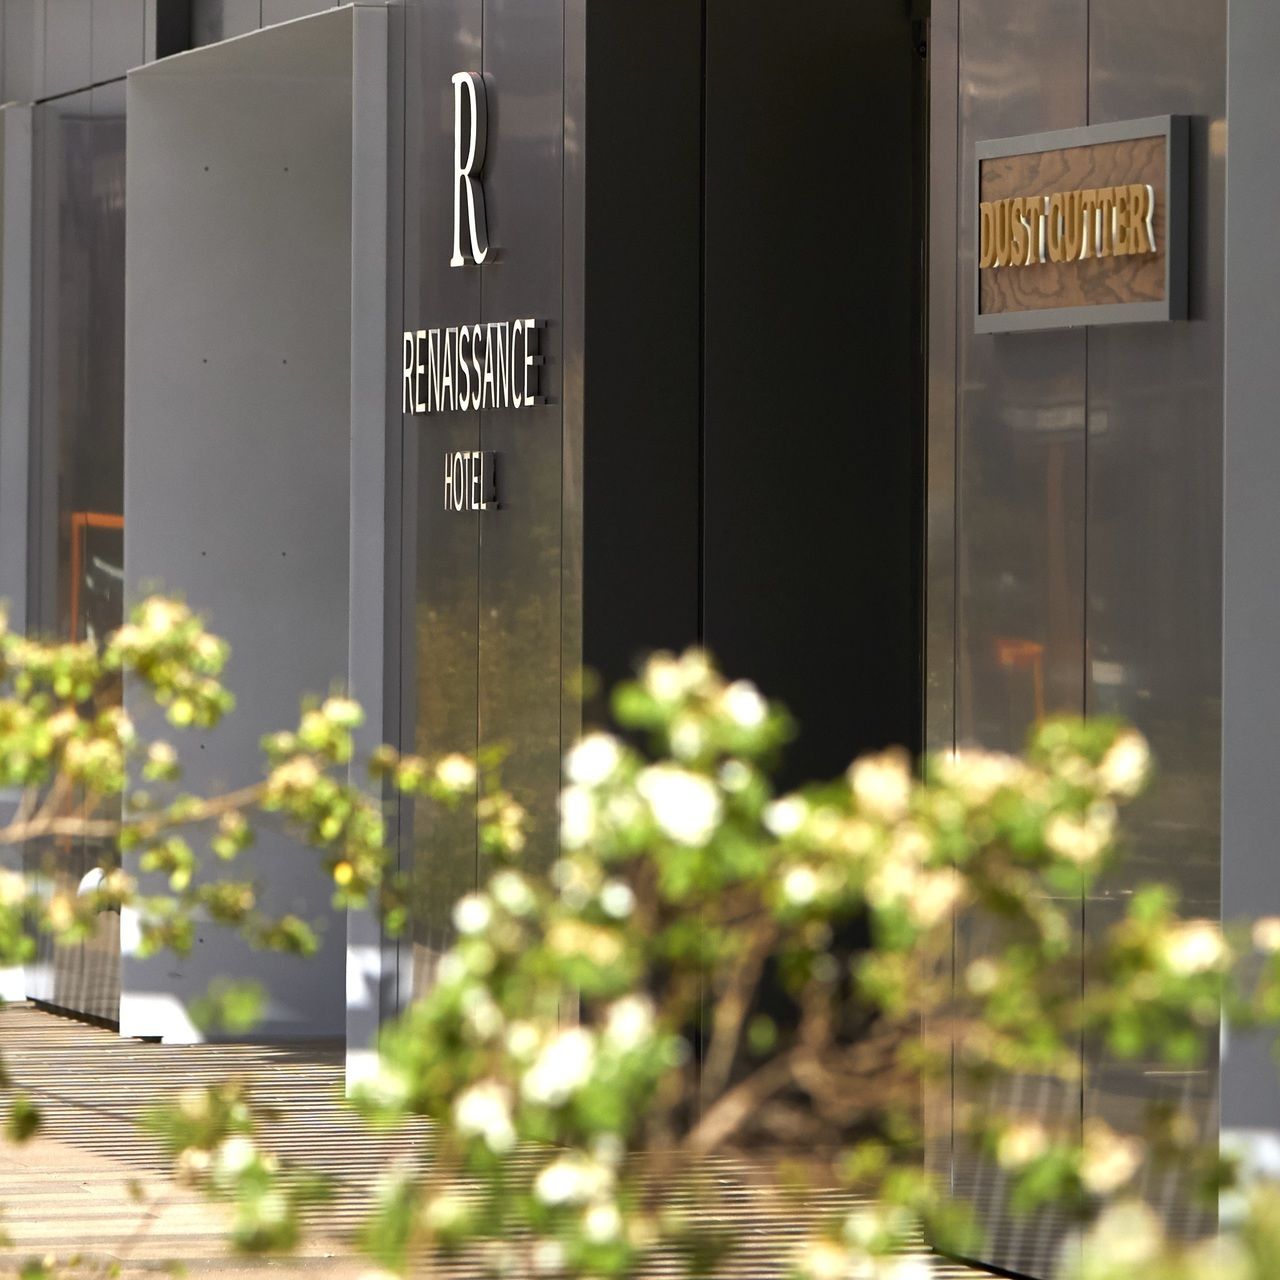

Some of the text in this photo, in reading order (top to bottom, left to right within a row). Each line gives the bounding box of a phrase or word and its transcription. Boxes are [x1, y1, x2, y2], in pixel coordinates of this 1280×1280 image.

[450, 71, 490, 268] R
[979, 184, 1153, 268] DUST CUTTER
[402, 318, 537, 415] RENAISSANCE
[443, 451, 488, 511] HOTEL
